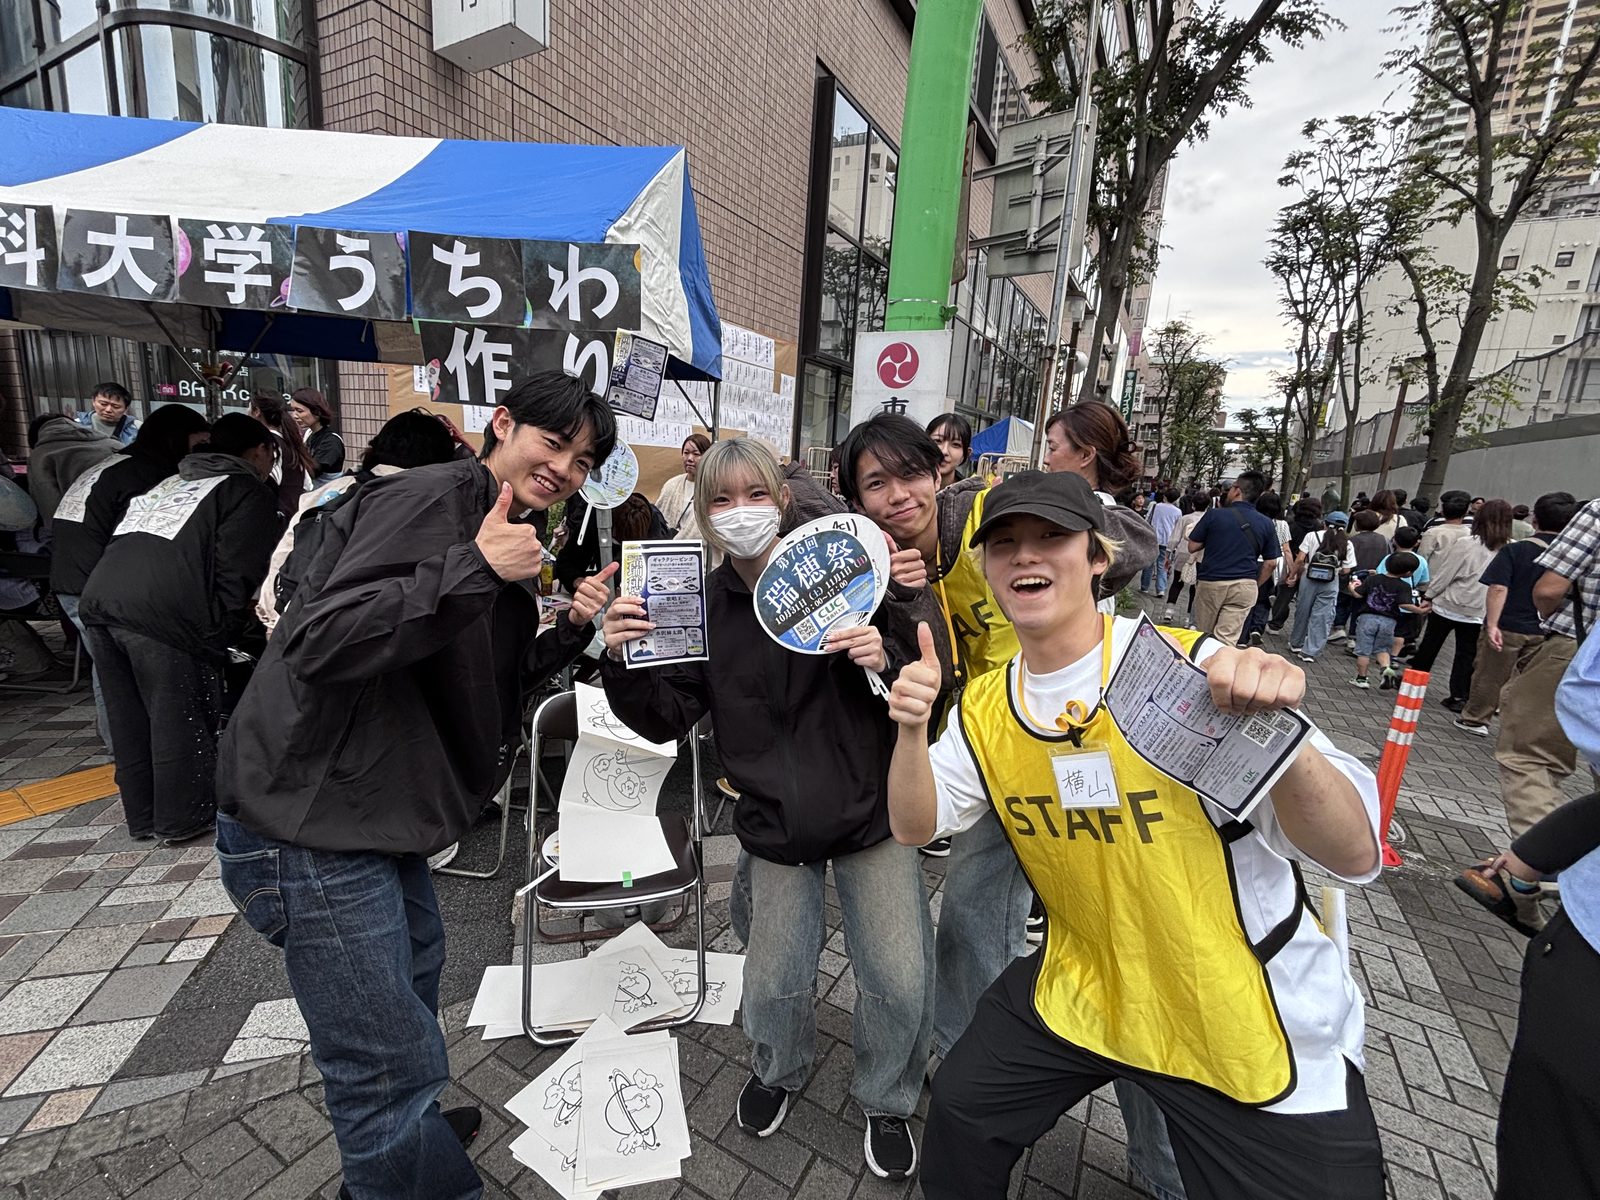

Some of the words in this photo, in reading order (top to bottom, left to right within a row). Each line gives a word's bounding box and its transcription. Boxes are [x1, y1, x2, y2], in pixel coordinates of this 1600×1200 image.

[444, 327, 609, 403] 作り
[762, 538, 854, 614] 瑞穂祭
[775, 536, 818, 572] 第76回
[817, 597, 844, 619] CUC
[1062, 769, 1111, 797] 横山
[1004, 790, 1164, 844] STAFF
